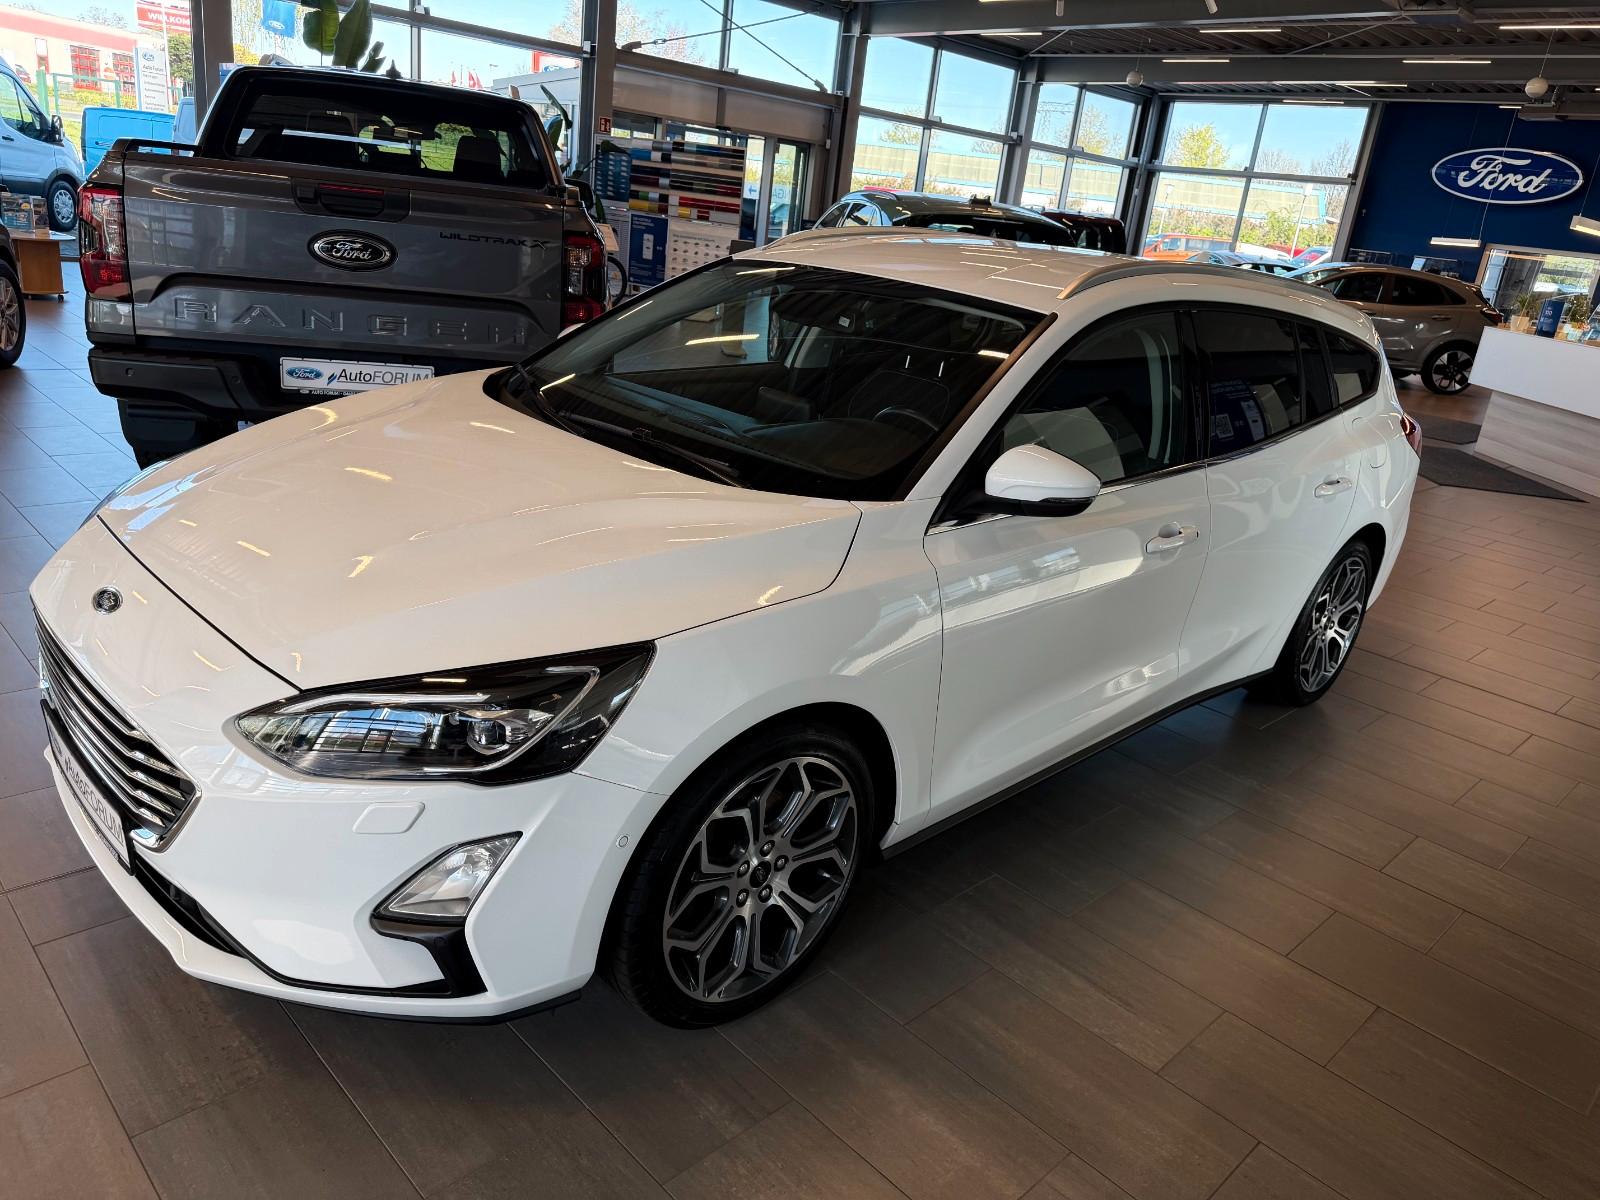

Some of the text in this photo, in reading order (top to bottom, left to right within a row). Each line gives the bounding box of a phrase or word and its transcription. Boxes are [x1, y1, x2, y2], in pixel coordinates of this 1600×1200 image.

[1457, 154, 1553, 195] Ford
[439, 231, 551, 249] WILDTRAK X
[329, 241, 373, 261] Ford
